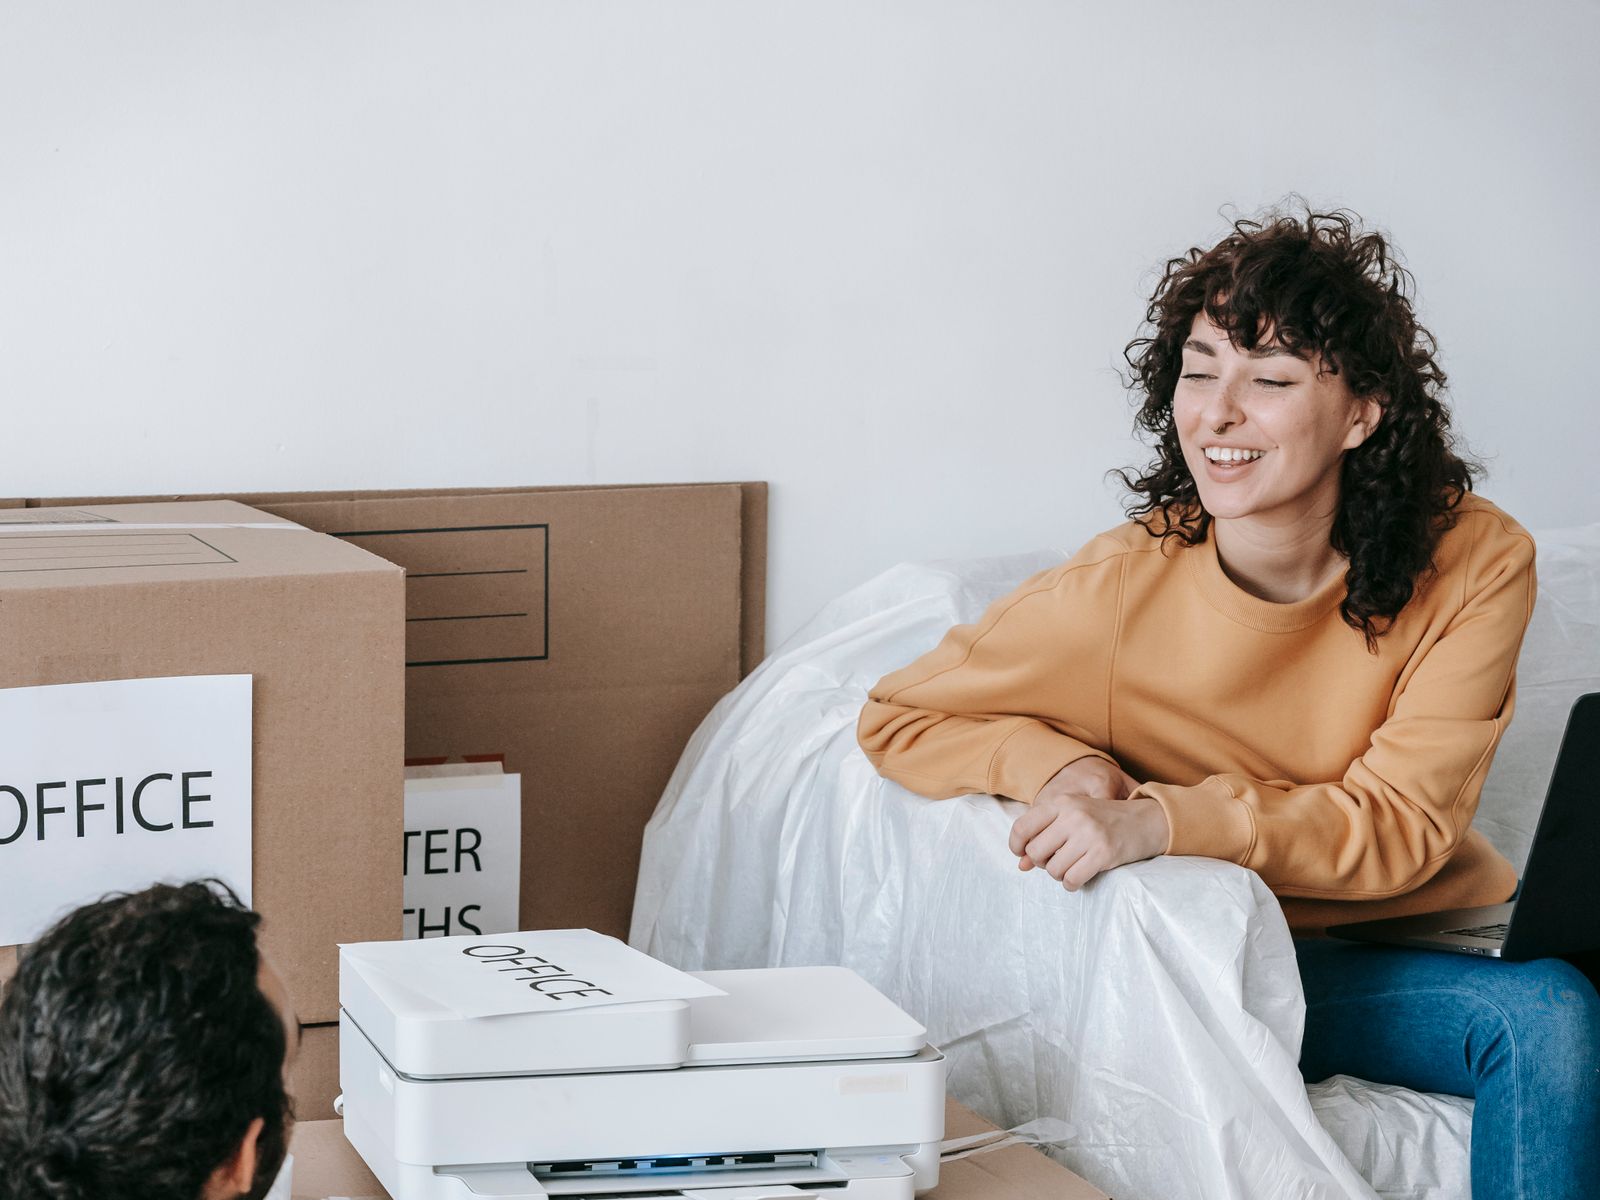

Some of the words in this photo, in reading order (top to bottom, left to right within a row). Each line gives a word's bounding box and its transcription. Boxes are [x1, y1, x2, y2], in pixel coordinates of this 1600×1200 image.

[0, 771, 214, 845] OFFICE
[403, 905, 482, 939] HS
[462, 945, 614, 1001] OFFICE
